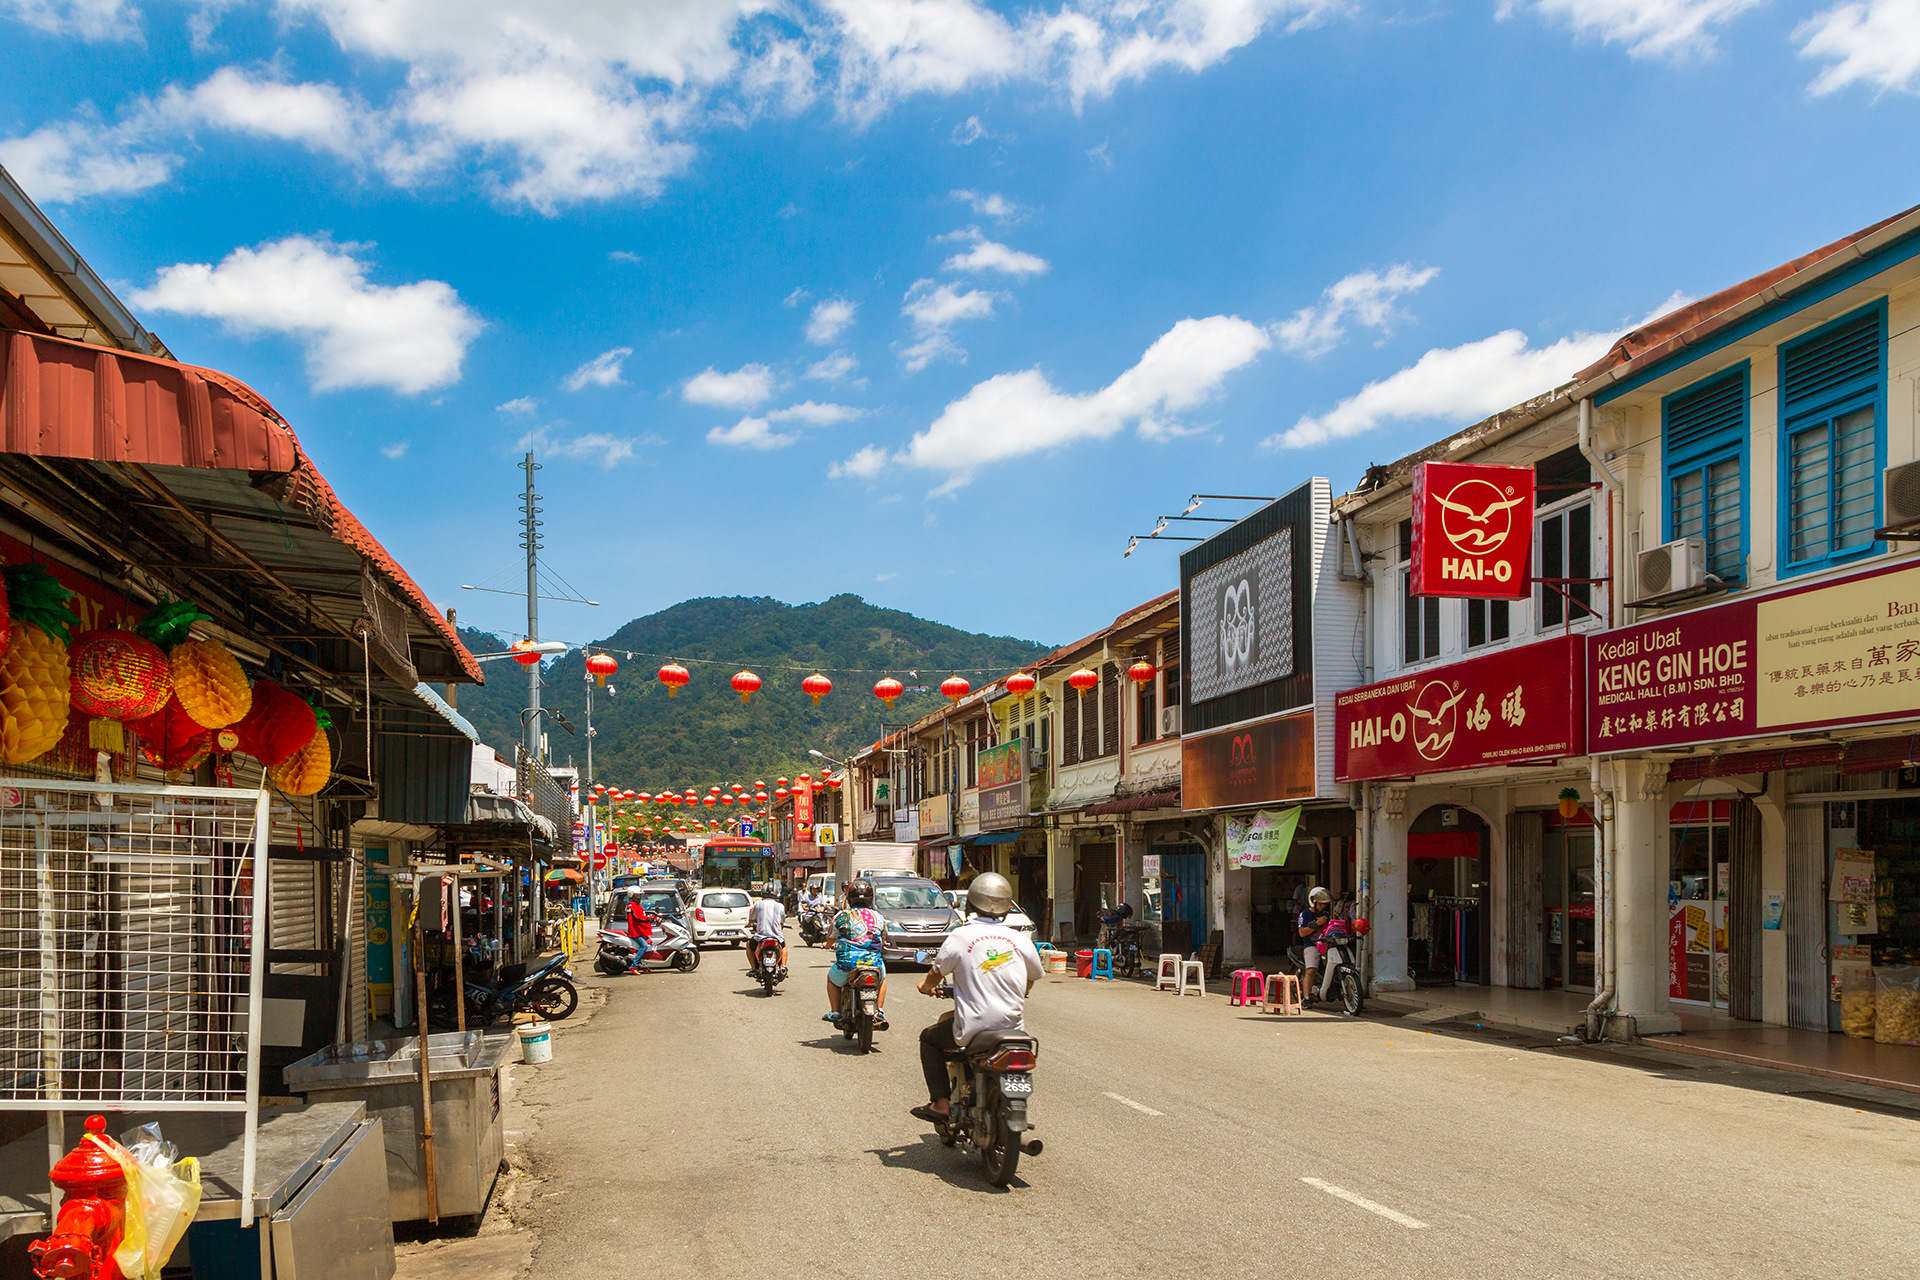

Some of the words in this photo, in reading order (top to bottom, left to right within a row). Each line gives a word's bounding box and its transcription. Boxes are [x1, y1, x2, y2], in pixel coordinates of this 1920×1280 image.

[1442, 557, 1512, 582] HAI-O
[1780, 626, 1813, 639] tradisional
[1814, 624, 1830, 633] yang
[1830, 616, 1863, 629] berkualiti
[1863, 613, 1879, 623] dari
[1801, 639, 1817, 648] yang
[1817, 635, 1834, 644] riang
[1835, 630, 1857, 640] adalah
[1859, 627, 1875, 636] ubat
[1875, 624, 1893, 633] yang
[1598, 636, 1639, 662] Kedai
[1643, 627, 1681, 652] Ubat
[1598, 659, 1650, 693] KENG
[1656, 651, 1692, 682] GIN
[1699, 640, 1747, 675] HOE
[1338, 697, 1354, 706] KEDAI
[1354, 686, 1386, 703] SERBANEKA
[1386, 683, 1400, 695] DAN
[1400, 680, 1416, 692] UBAT
[1599, 690, 1636, 706] MEDICAL
[1637, 686, 1661, 700] HALL
[1693, 677, 1718, 691] SDN.
[1719, 673, 1745, 687] BHD.
[1350, 712, 1406, 749] HAI-O
[1499, 749, 1510, 757] OLEH
[1523, 746, 1534, 754] RAYA
[996, 804, 1021, 819] ENTERPRISE
[981, 935, 1018, 951] ENTERPRISE
[1004, 1082, 1032, 1093] 2695
